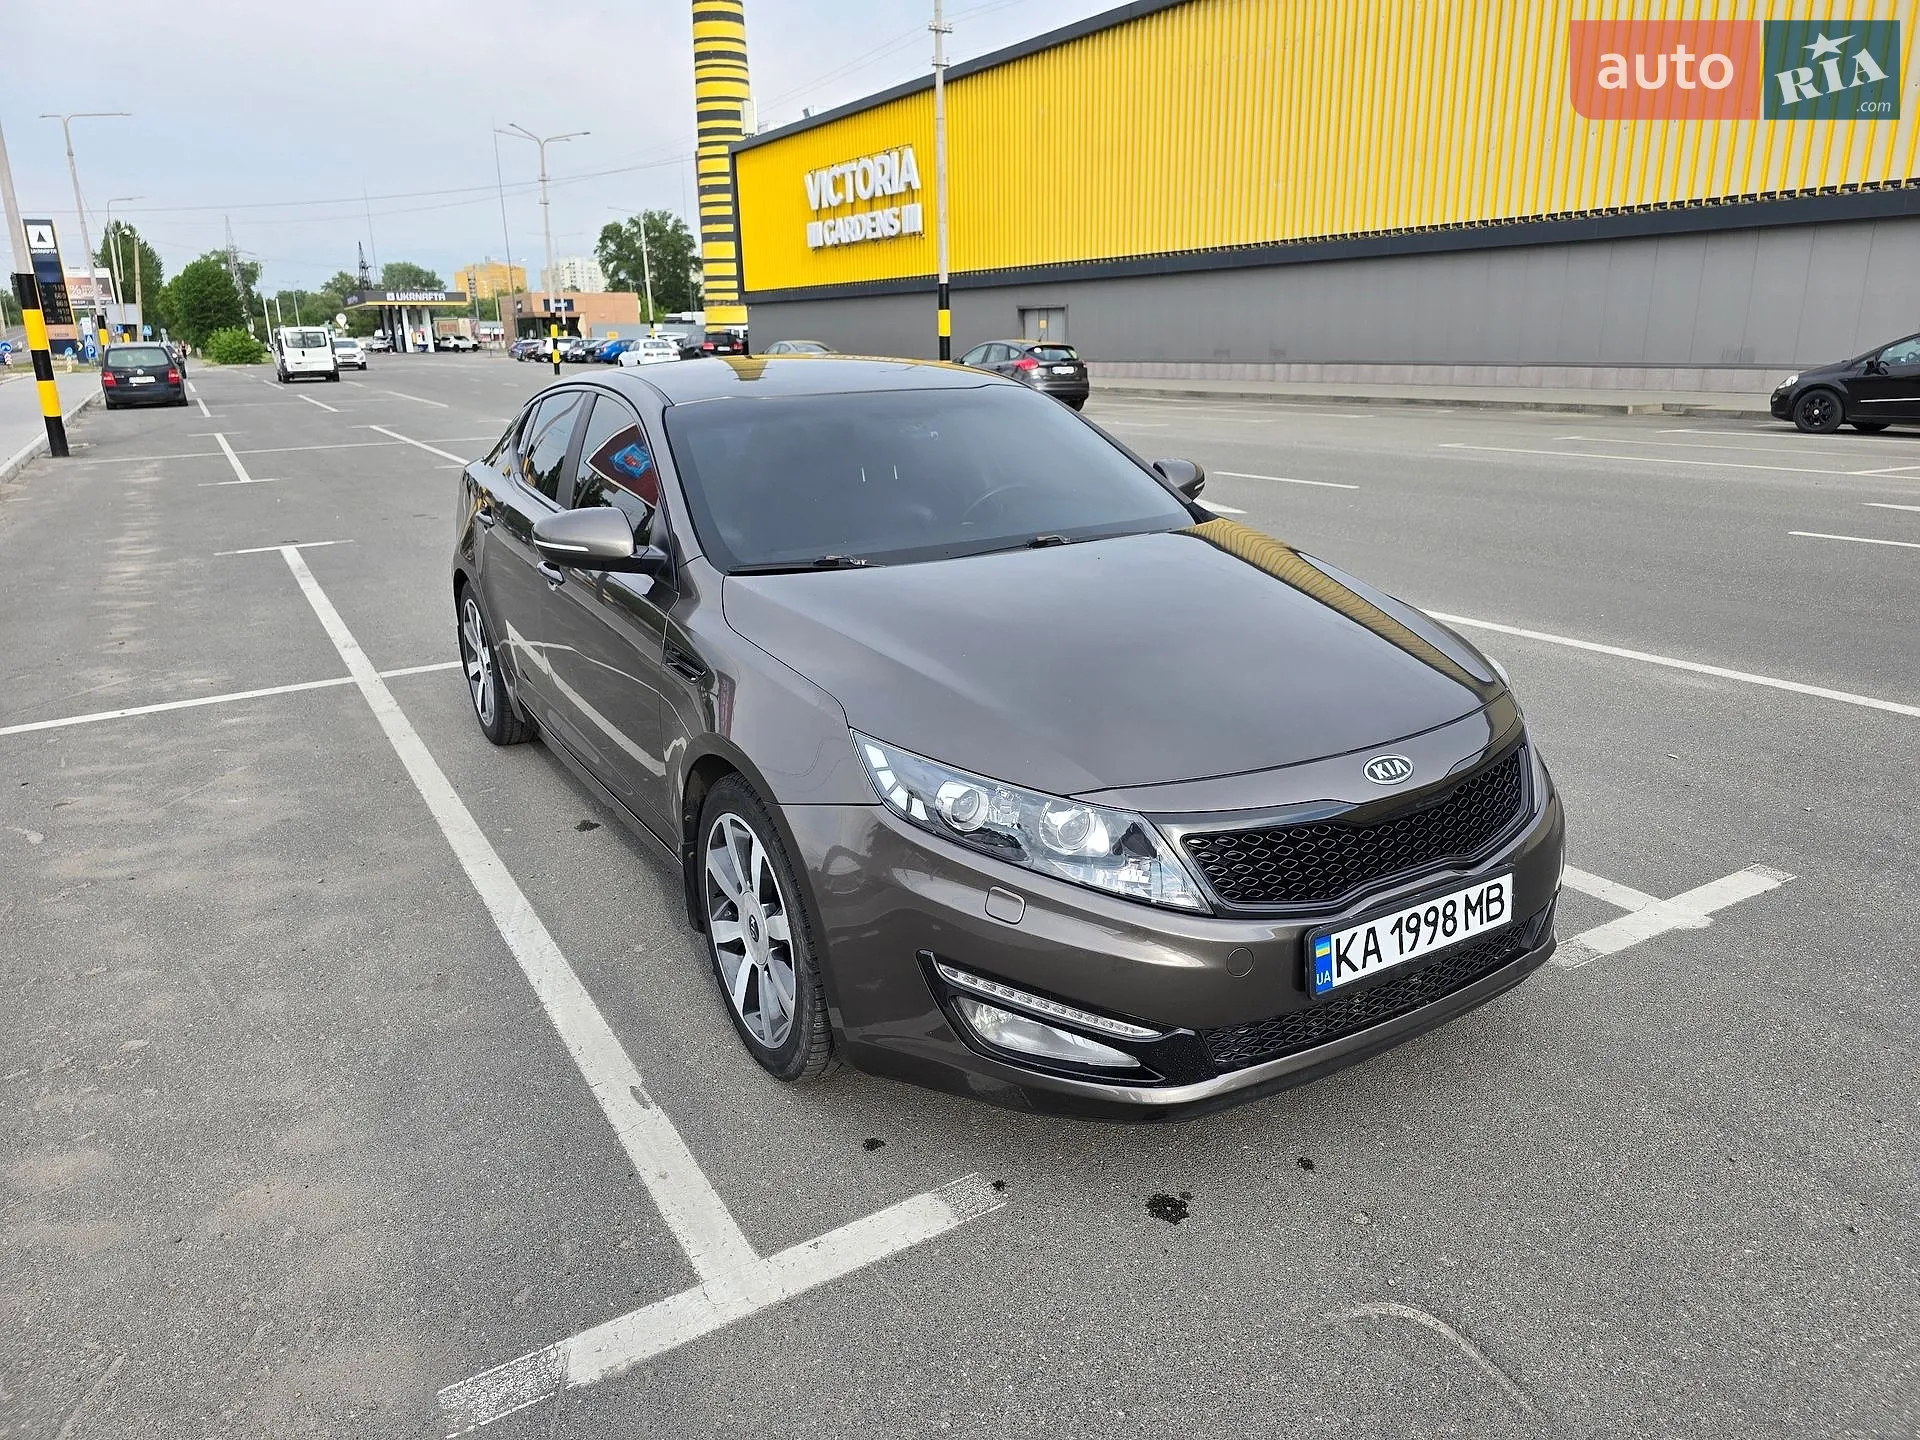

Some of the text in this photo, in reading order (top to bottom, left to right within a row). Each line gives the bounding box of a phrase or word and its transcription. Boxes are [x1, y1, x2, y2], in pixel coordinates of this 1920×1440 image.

[804, 147, 921, 210] VICTORIA
[822, 207, 901, 245] GARDENS
[1371, 757, 1408, 780] KIA
[1335, 882, 1505, 978] KA 1998 MB
[1316, 970, 1331, 985] UA
